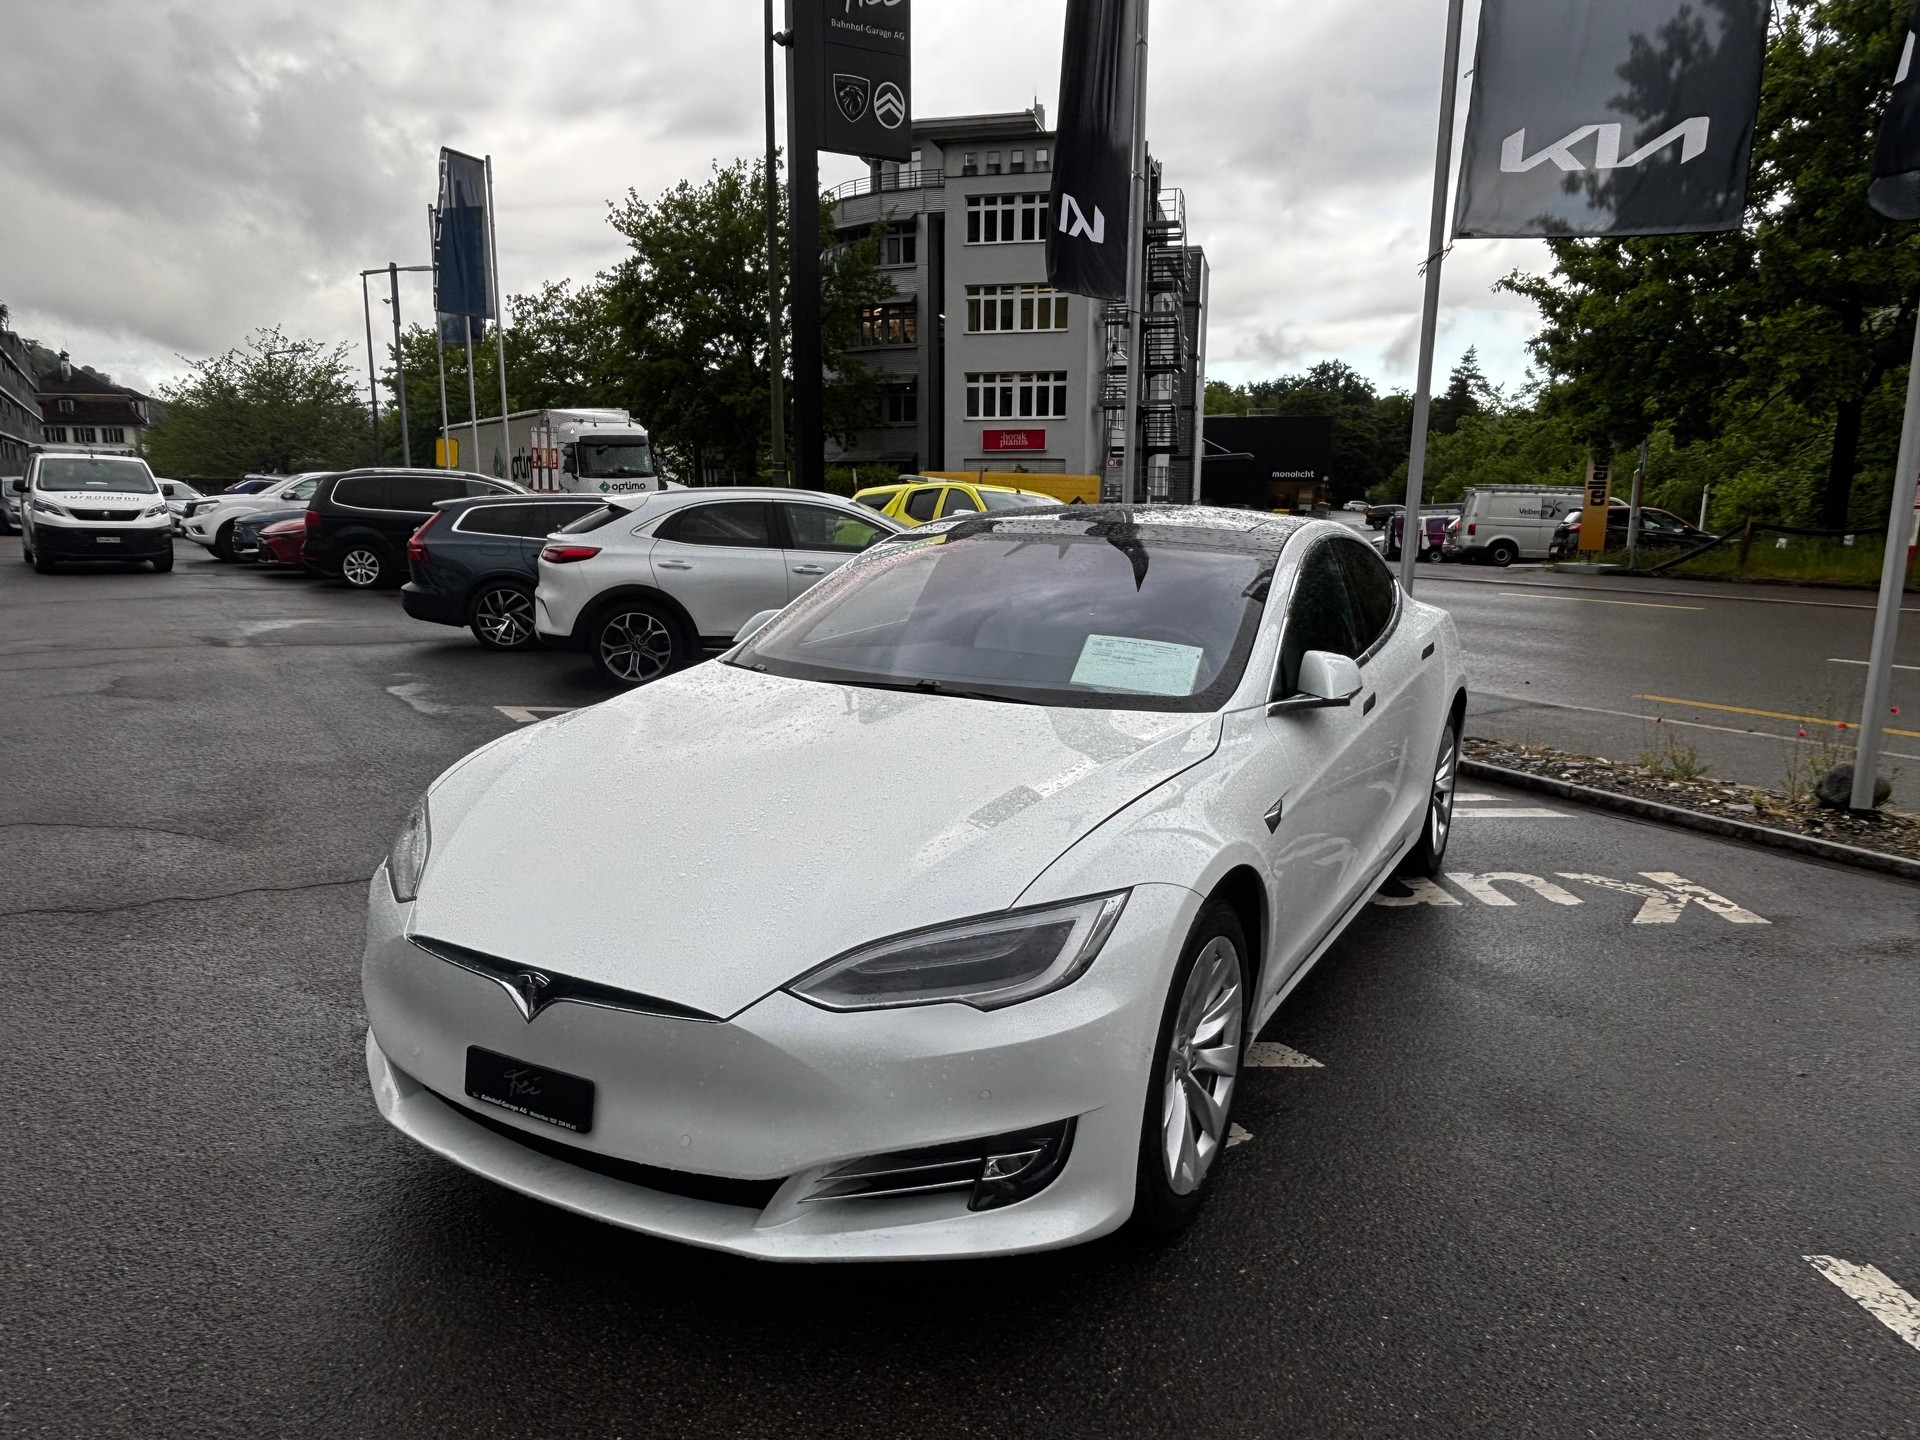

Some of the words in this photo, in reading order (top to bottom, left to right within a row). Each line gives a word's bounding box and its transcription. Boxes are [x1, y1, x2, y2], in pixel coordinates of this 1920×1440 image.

[831, 18, 892, 38] Bahnhof-Garage
[893, 31, 905, 40] AG
[1500, 116, 1710, 173] KIA
[611, 481, 646, 493] optimo
